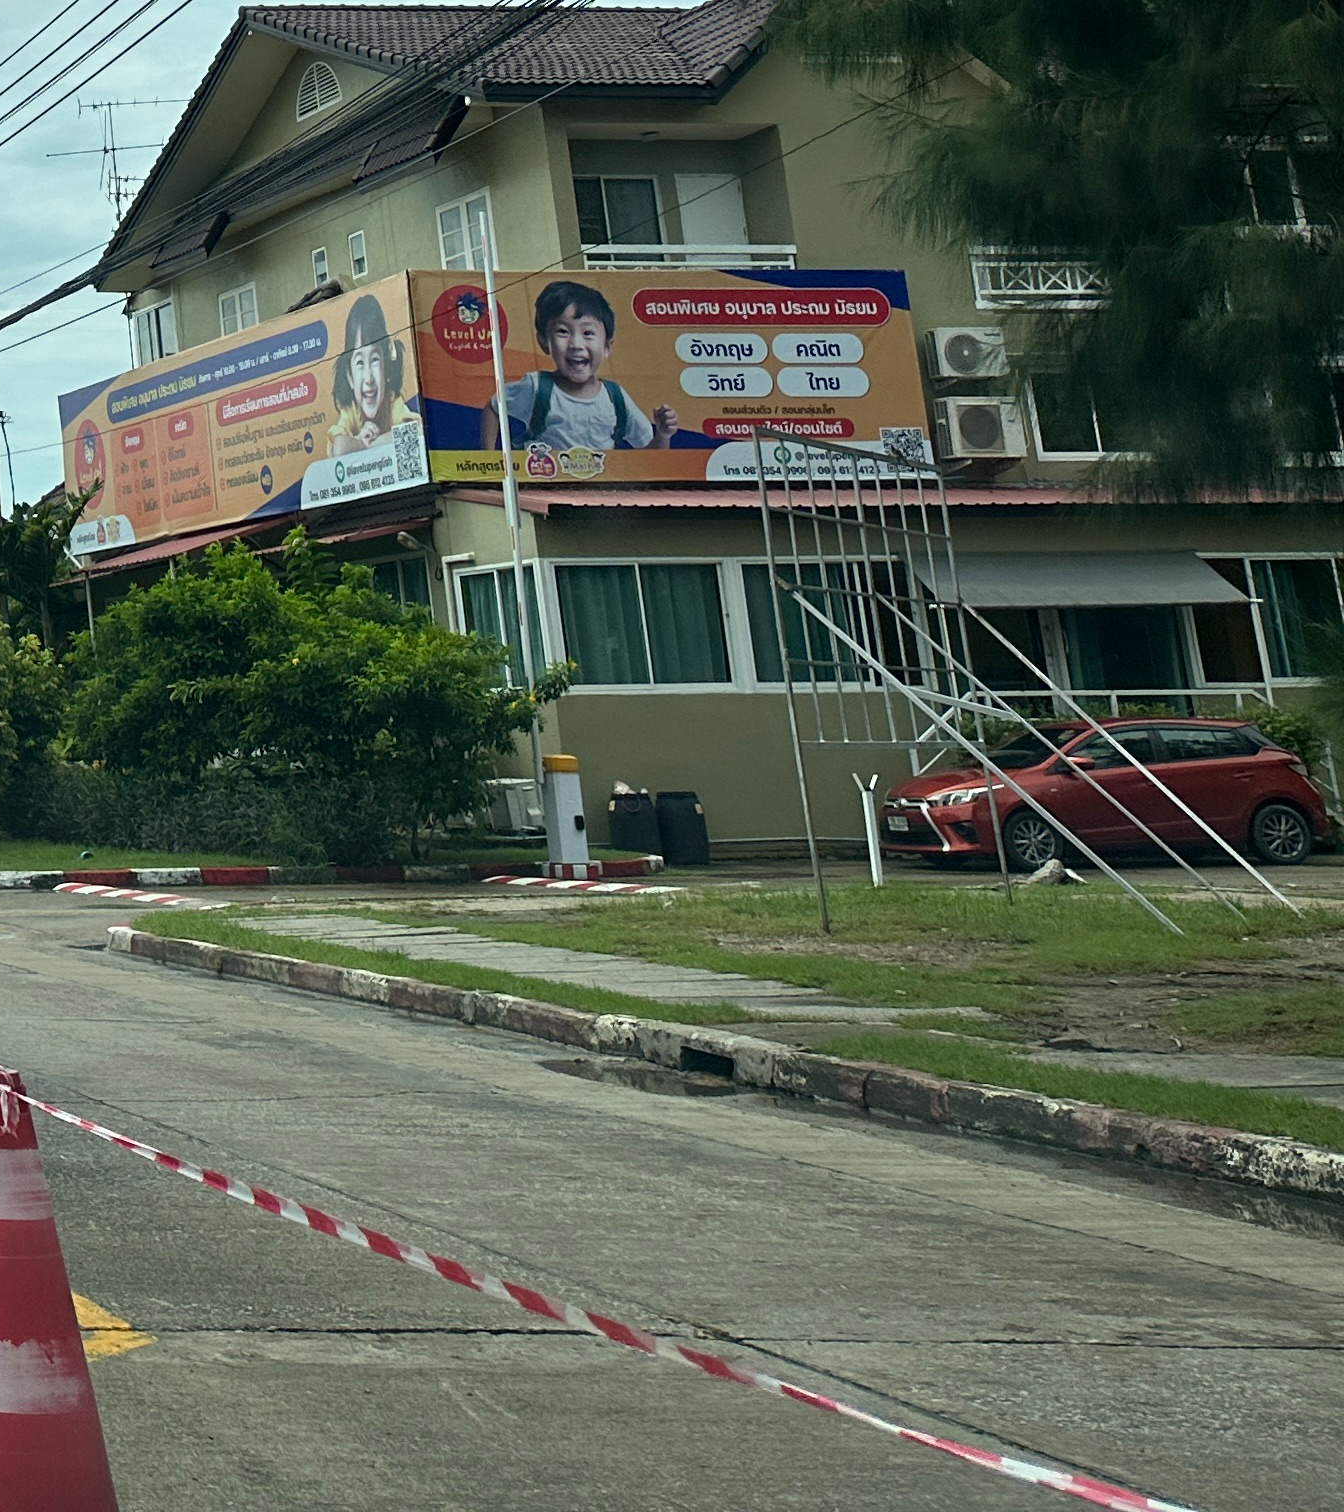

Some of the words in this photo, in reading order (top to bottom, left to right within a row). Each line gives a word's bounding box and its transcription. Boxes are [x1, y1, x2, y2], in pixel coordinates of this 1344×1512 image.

[645, 299, 720, 316] สอนพิเศษ
[725, 301, 777, 319] อนุบาล
[781, 300, 830, 316] ประถม
[835, 299, 878, 316] มัธยม
[690, 339, 753, 361] อังกฤษ
[796, 340, 841, 357] คณิต
[707, 374, 745, 391] วิทย์
[805, 372, 841, 391] ไทย
[456, 459, 520, 475] หลักสูตรโย
[743, 465, 759, 475] 08
